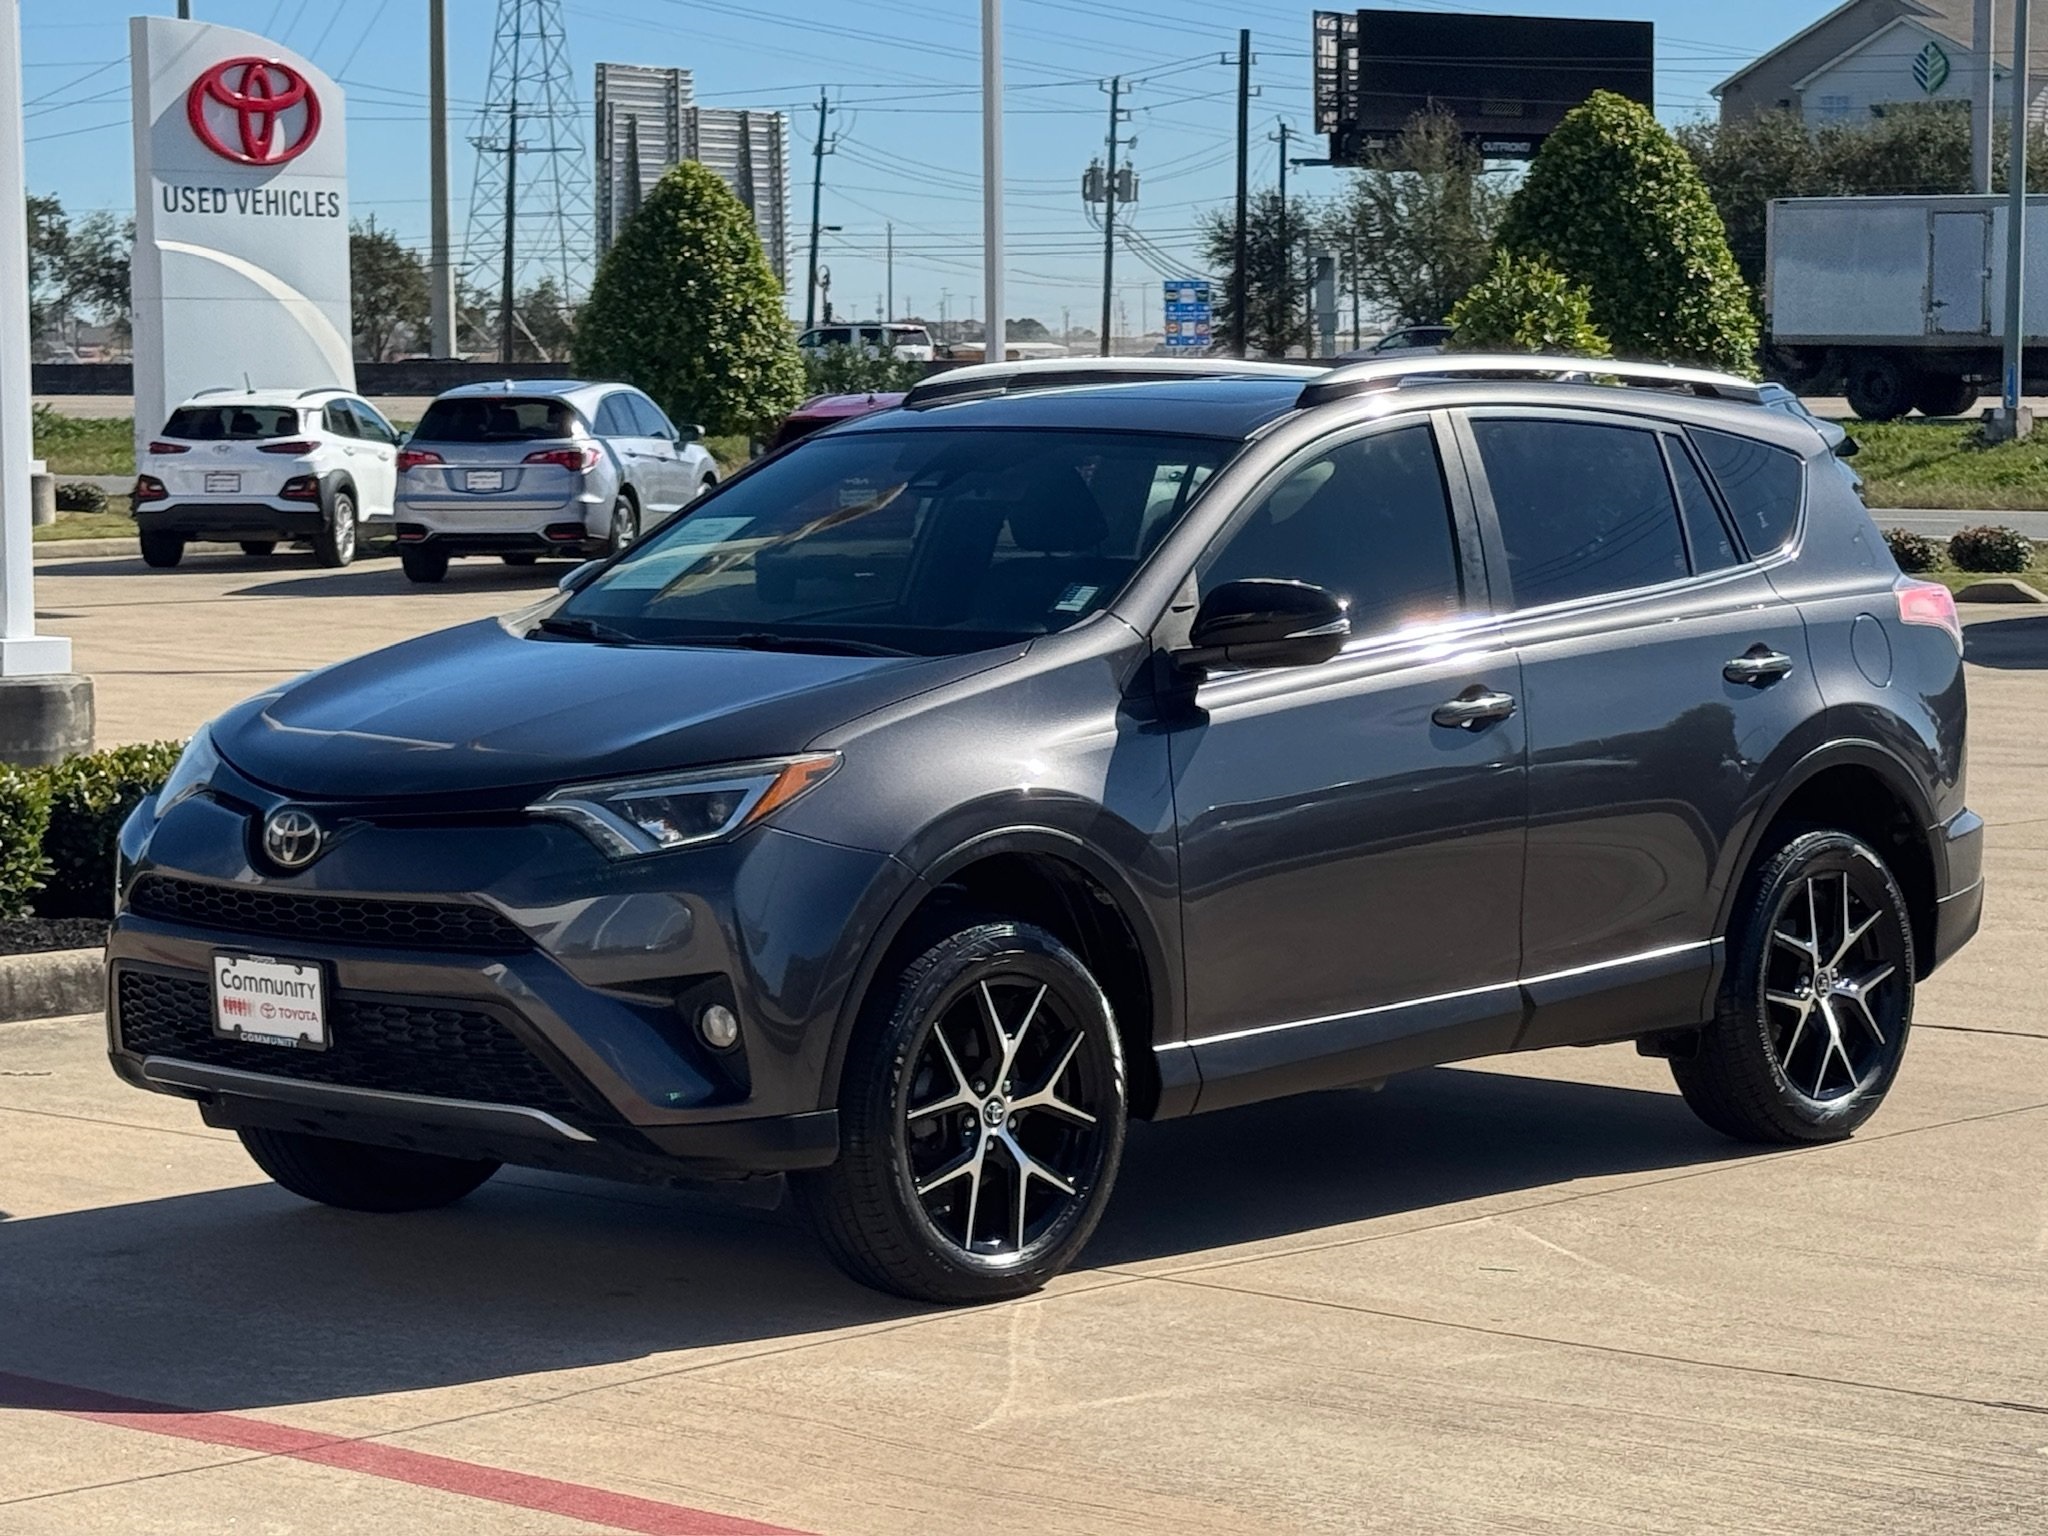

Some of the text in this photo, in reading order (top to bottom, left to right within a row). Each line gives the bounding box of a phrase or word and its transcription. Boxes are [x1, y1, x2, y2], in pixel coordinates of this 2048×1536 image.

[162, 185, 341, 218] USED VEHICLES
[278, 1007, 319, 1022] TOYOTA
